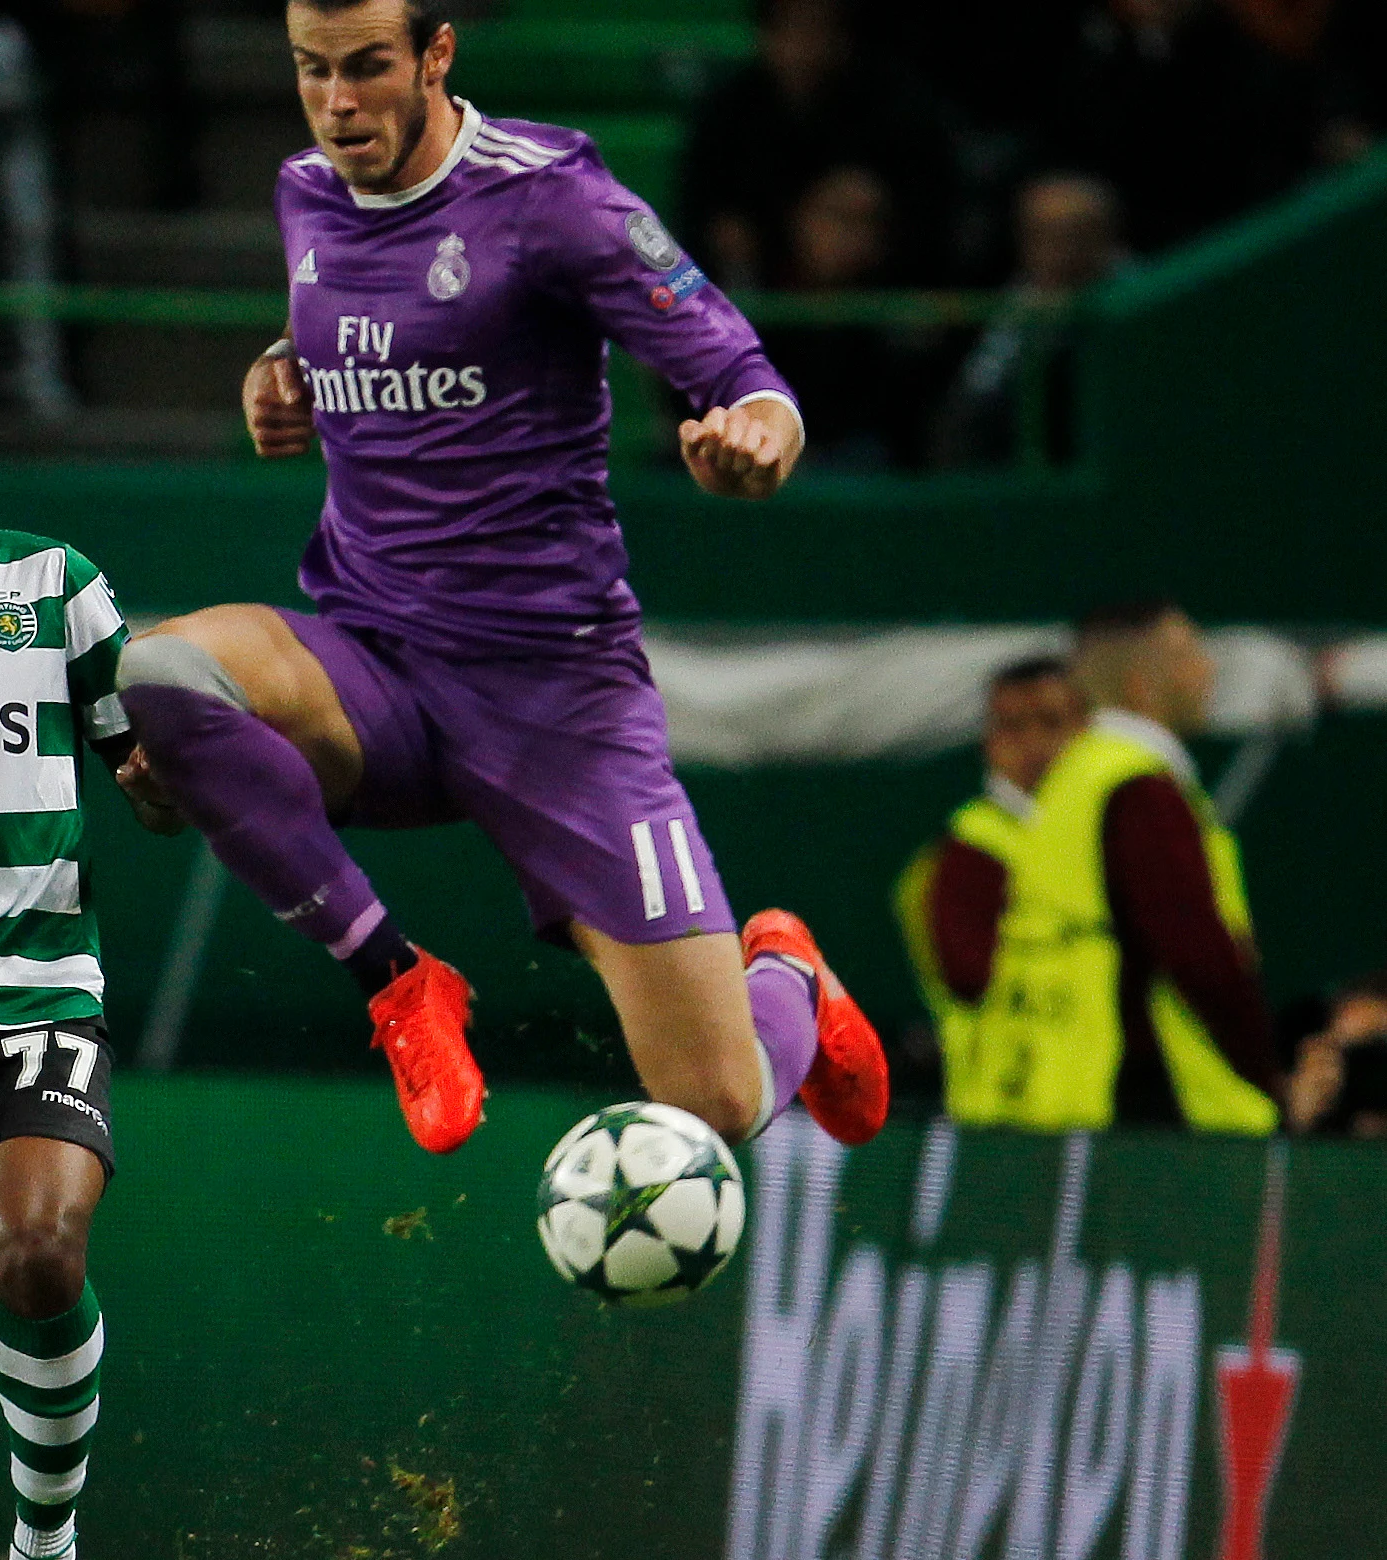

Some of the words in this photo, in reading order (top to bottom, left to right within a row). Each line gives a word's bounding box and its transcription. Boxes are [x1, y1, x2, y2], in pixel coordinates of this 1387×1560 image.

[337, 315, 395, 362] Fly
[298, 356, 488, 414] mirates
[630, 817, 706, 921] 11
[0, 1030, 99, 1094] 77
